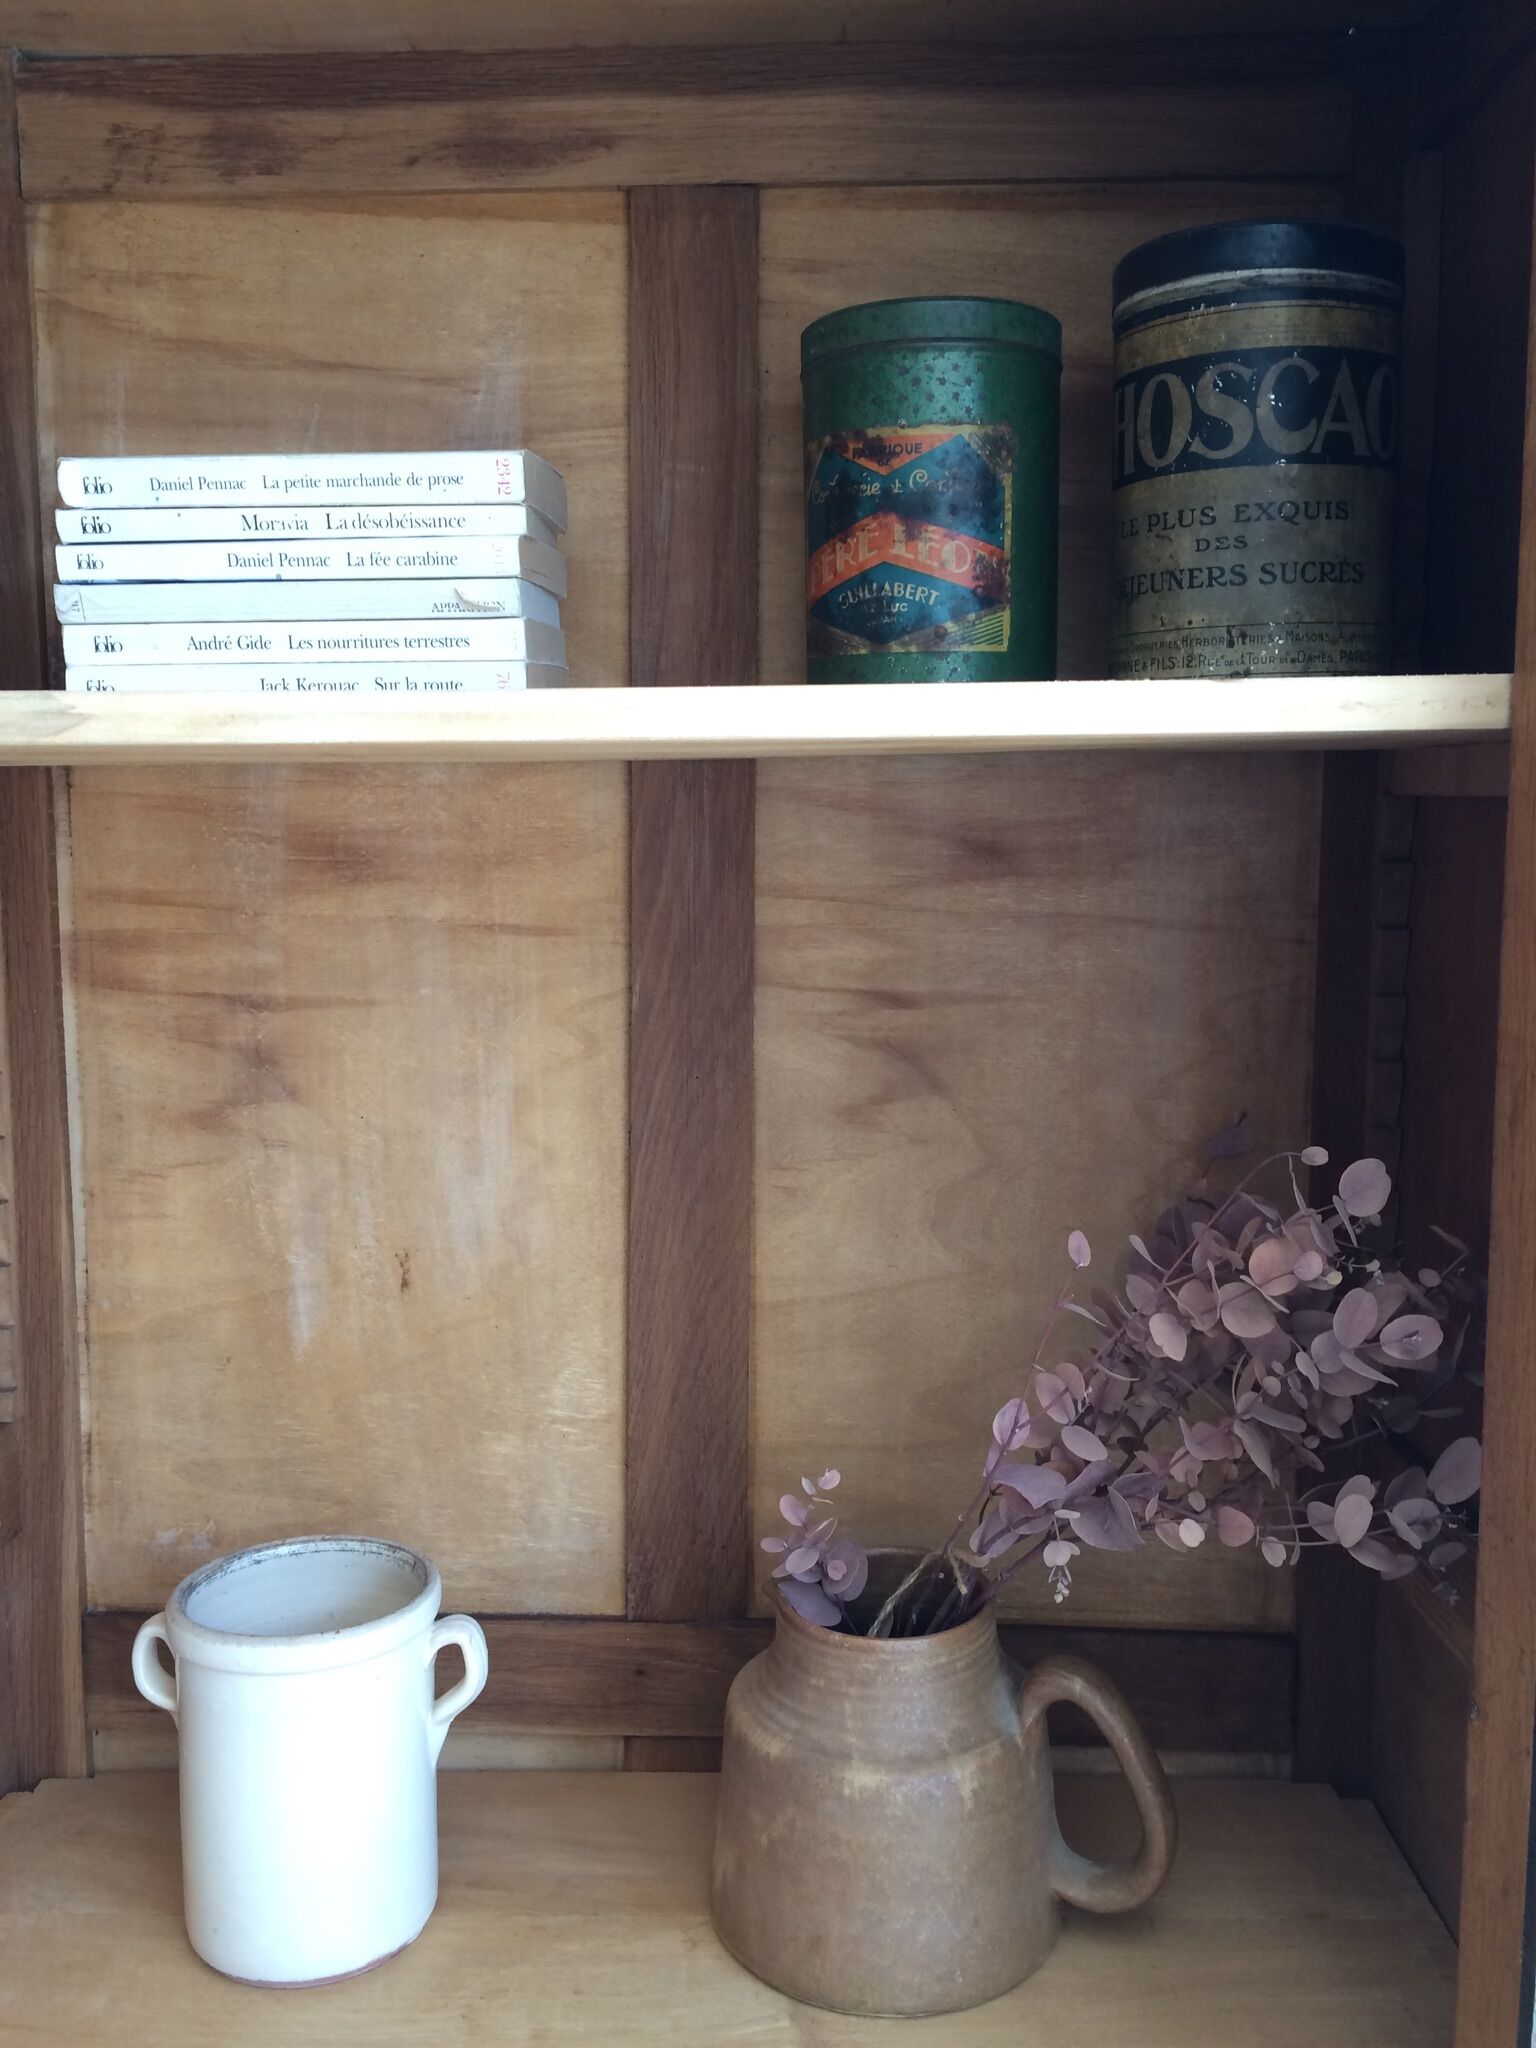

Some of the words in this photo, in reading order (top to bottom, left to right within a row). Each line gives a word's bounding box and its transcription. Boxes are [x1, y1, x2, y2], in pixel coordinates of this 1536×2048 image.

[82, 476, 113, 495] folio
[149, 476, 193, 492] Daniel
[198, 476, 247, 490] Pennac
[262, 475, 280, 489] La
[283, 474, 321, 493] petite
[325, 472, 402, 488] marchande
[406, 471, 423, 486] de
[427, 473, 464, 490] prose
[494, 457, 512, 496] 2342
[79, 515, 112, 535] folio
[325, 512, 348, 531] La
[351, 511, 466, 531] désobéissance
[1120, 518, 1140, 540] LE
[1146, 506, 1217, 534] PLUS
[1231, 500, 1350, 526] EXQUIS
[1194, 535, 1248, 553] DES
[75, 553, 105, 570] folio
[226, 552, 274, 569] Daniel
[279, 552, 331, 568] Pennac
[346, 551, 365, 567] La
[369, 550, 391, 567] fée
[396, 550, 459, 567] carabine
[93, 634, 124, 654] folio
[186, 634, 233, 651] André
[236, 634, 272, 650] Gide
[288, 634, 313, 650] Les
[317, 633, 400, 650] nourritures
[404, 635, 471, 649] terrestres
[1181, 633, 1274, 648] HERBORITERIES
[1246, 651, 1277, 666] TOUR
[296, 677, 359, 692] Kerouac
[374, 676, 401, 691] Sur
[405, 676, 418, 691] la
[423, 679, 464, 691] route
